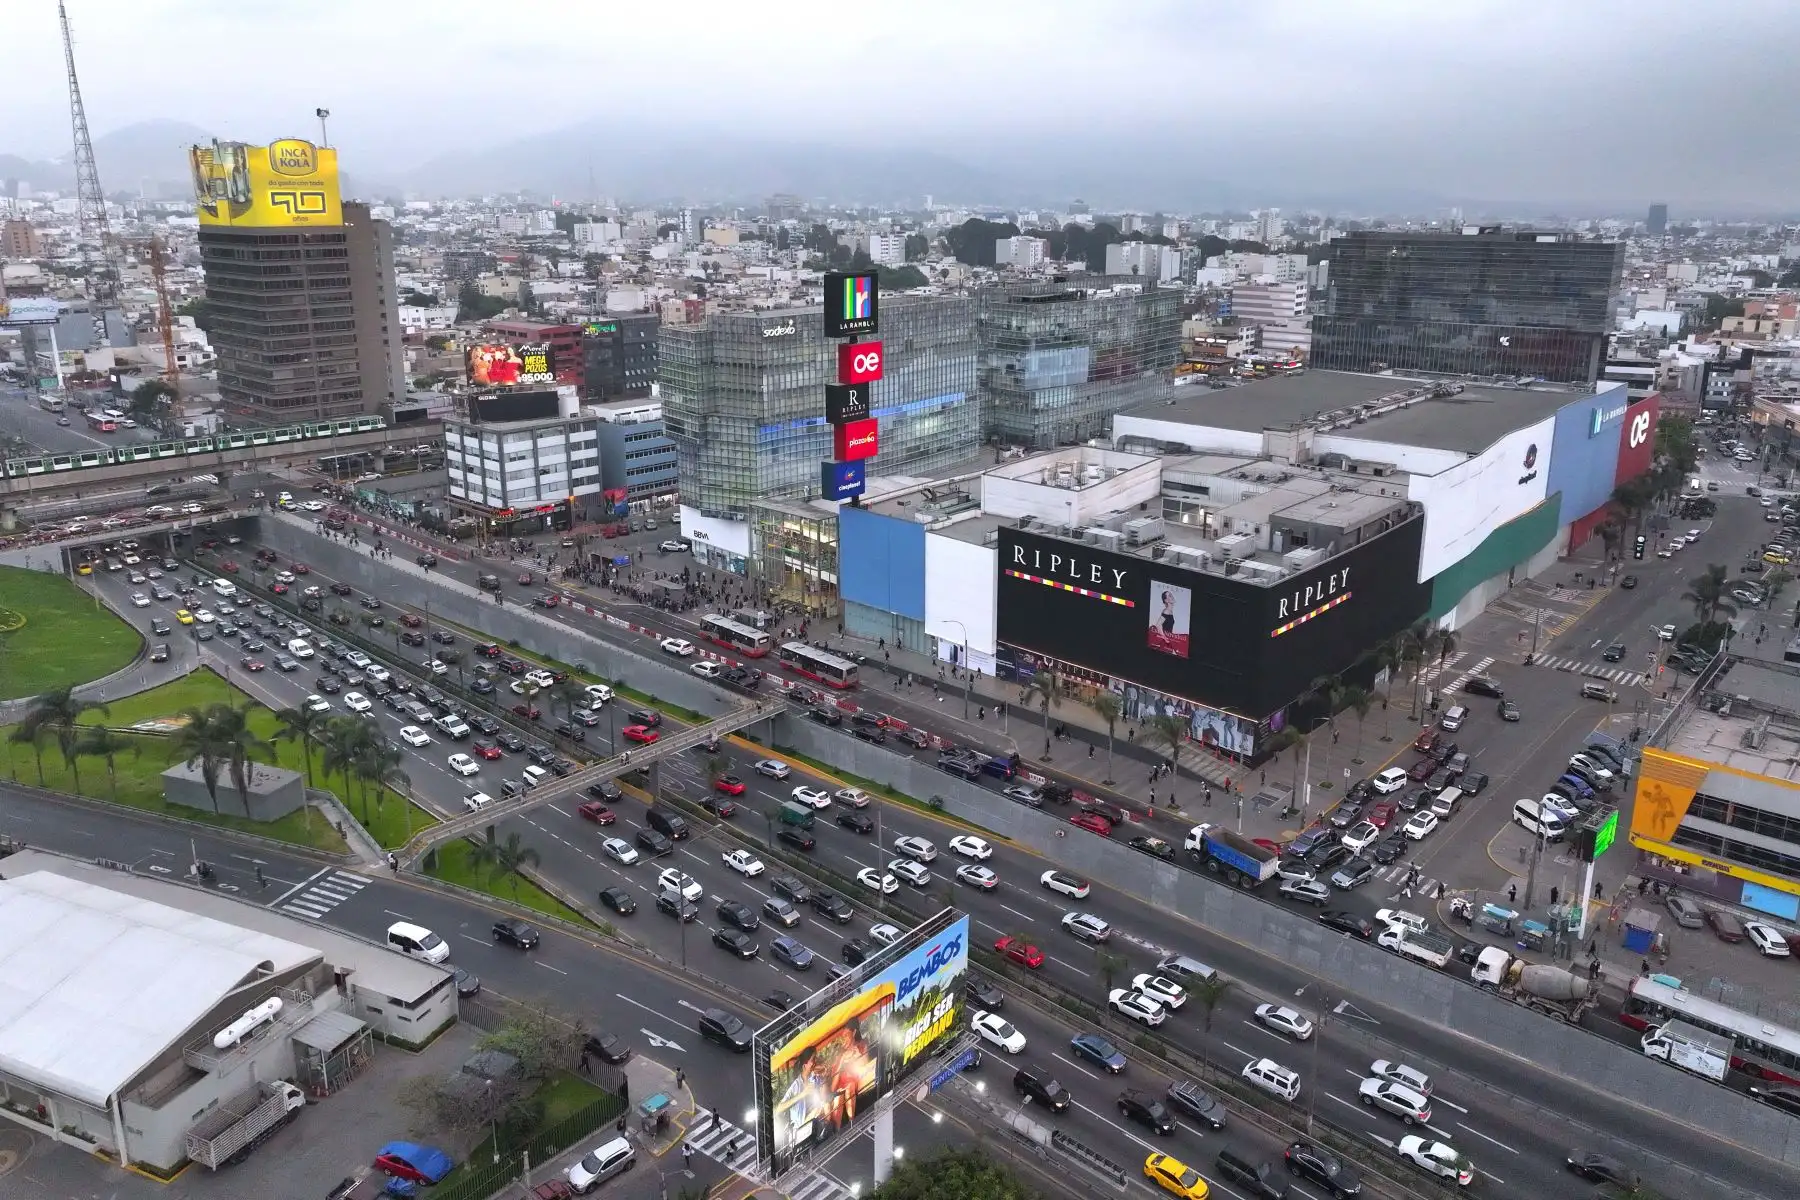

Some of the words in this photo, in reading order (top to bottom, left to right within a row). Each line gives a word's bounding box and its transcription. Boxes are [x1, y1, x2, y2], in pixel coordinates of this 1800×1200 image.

[281, 148, 308, 157] INCA
[280, 158, 310, 167] KOLA
[763, 322, 796, 338] sodexo
[849, 320, 875, 329] RAMBLA
[524, 355, 546, 365] MEGA
[853, 352, 879, 374] oe
[849, 390, 859, 406] R
[842, 403, 866, 413] RIPLEY
[693, 529, 709, 541] BBVA
[1013, 545, 1127, 589] RIPLEY
[1278, 567, 1351, 619] RIPLEY
[1057, 662, 1104, 681] RIPLEY
[897, 933, 963, 1003] BEMBOS
[904, 1012, 931, 1048] RICO
[932, 992, 954, 1023] SER
[903, 1007, 955, 1067] PERUANO
